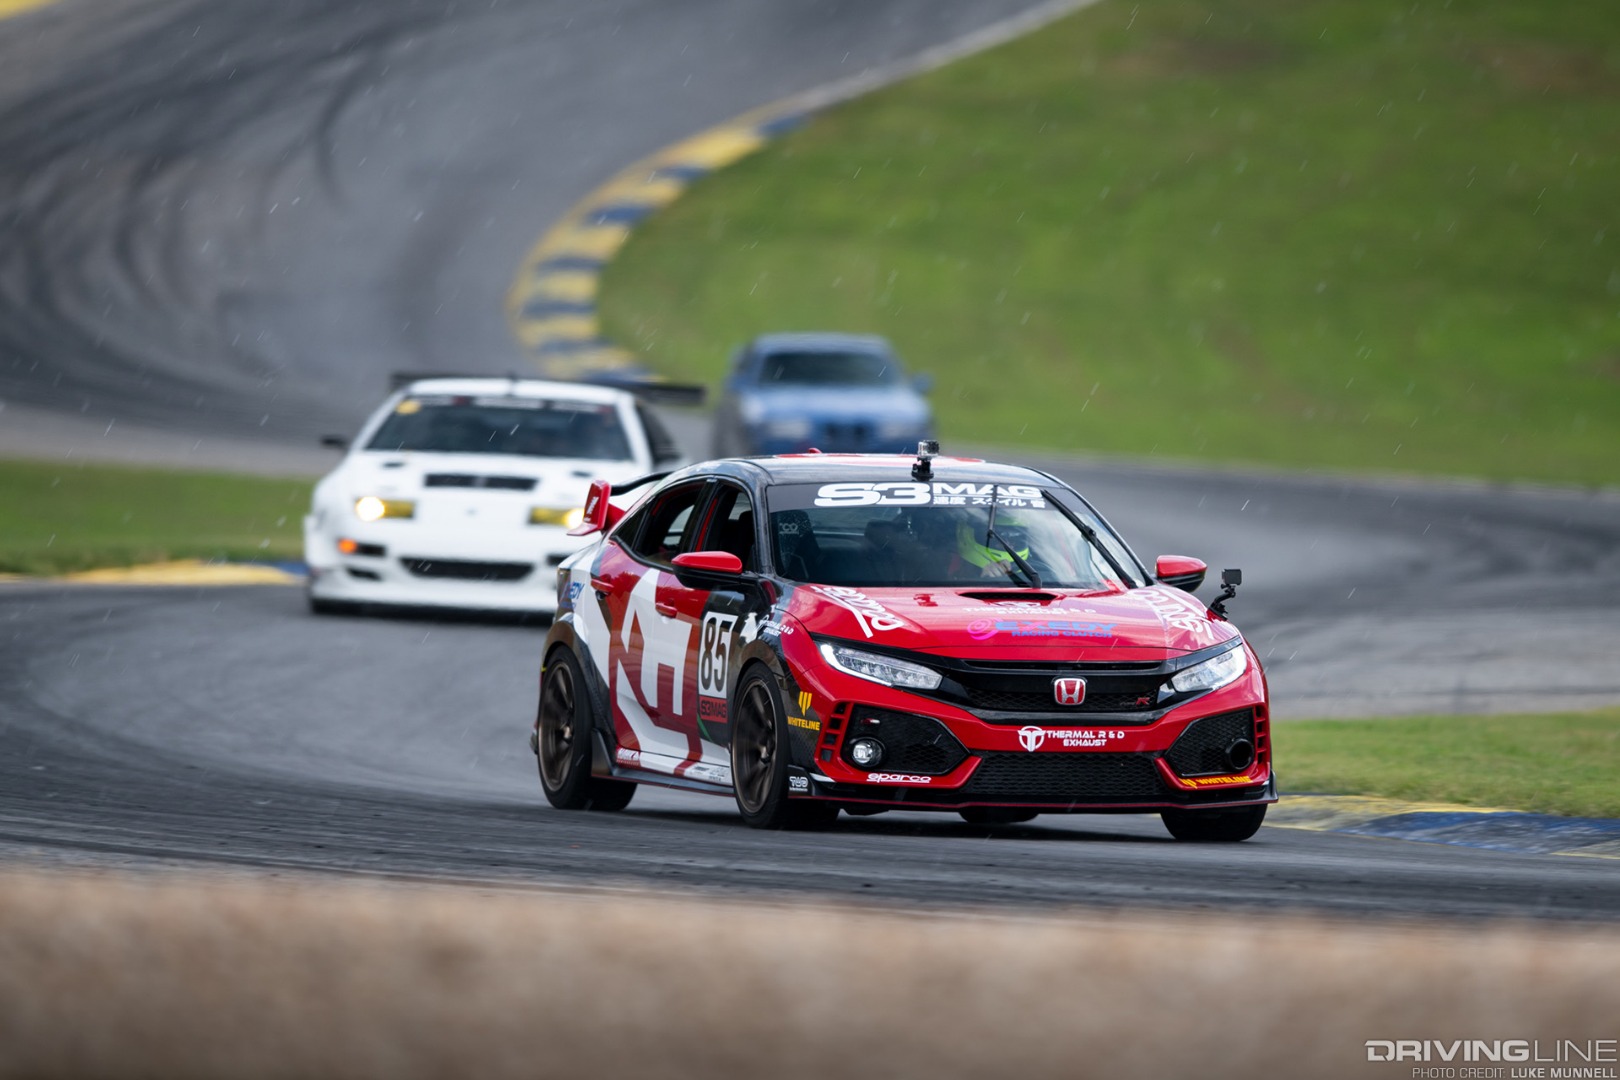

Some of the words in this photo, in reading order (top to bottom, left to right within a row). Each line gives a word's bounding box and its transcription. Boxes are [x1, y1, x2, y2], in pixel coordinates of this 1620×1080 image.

[814, 482, 931, 507] S3
[995, 620, 1119, 632] EXEDY
[701, 617, 734, 692] 85
[701, 700, 727, 718] S3MAG
[787, 716, 821, 731] WHITELINE
[1046, 730, 1096, 739] THERMAL
[1098, 730, 1106, 739] R
[1108, 731, 1115, 739] &
[1117, 731, 1125, 739] D
[1063, 739, 1107, 747] EXHAUST
[1196, 776, 1253, 785] WHITELINE
